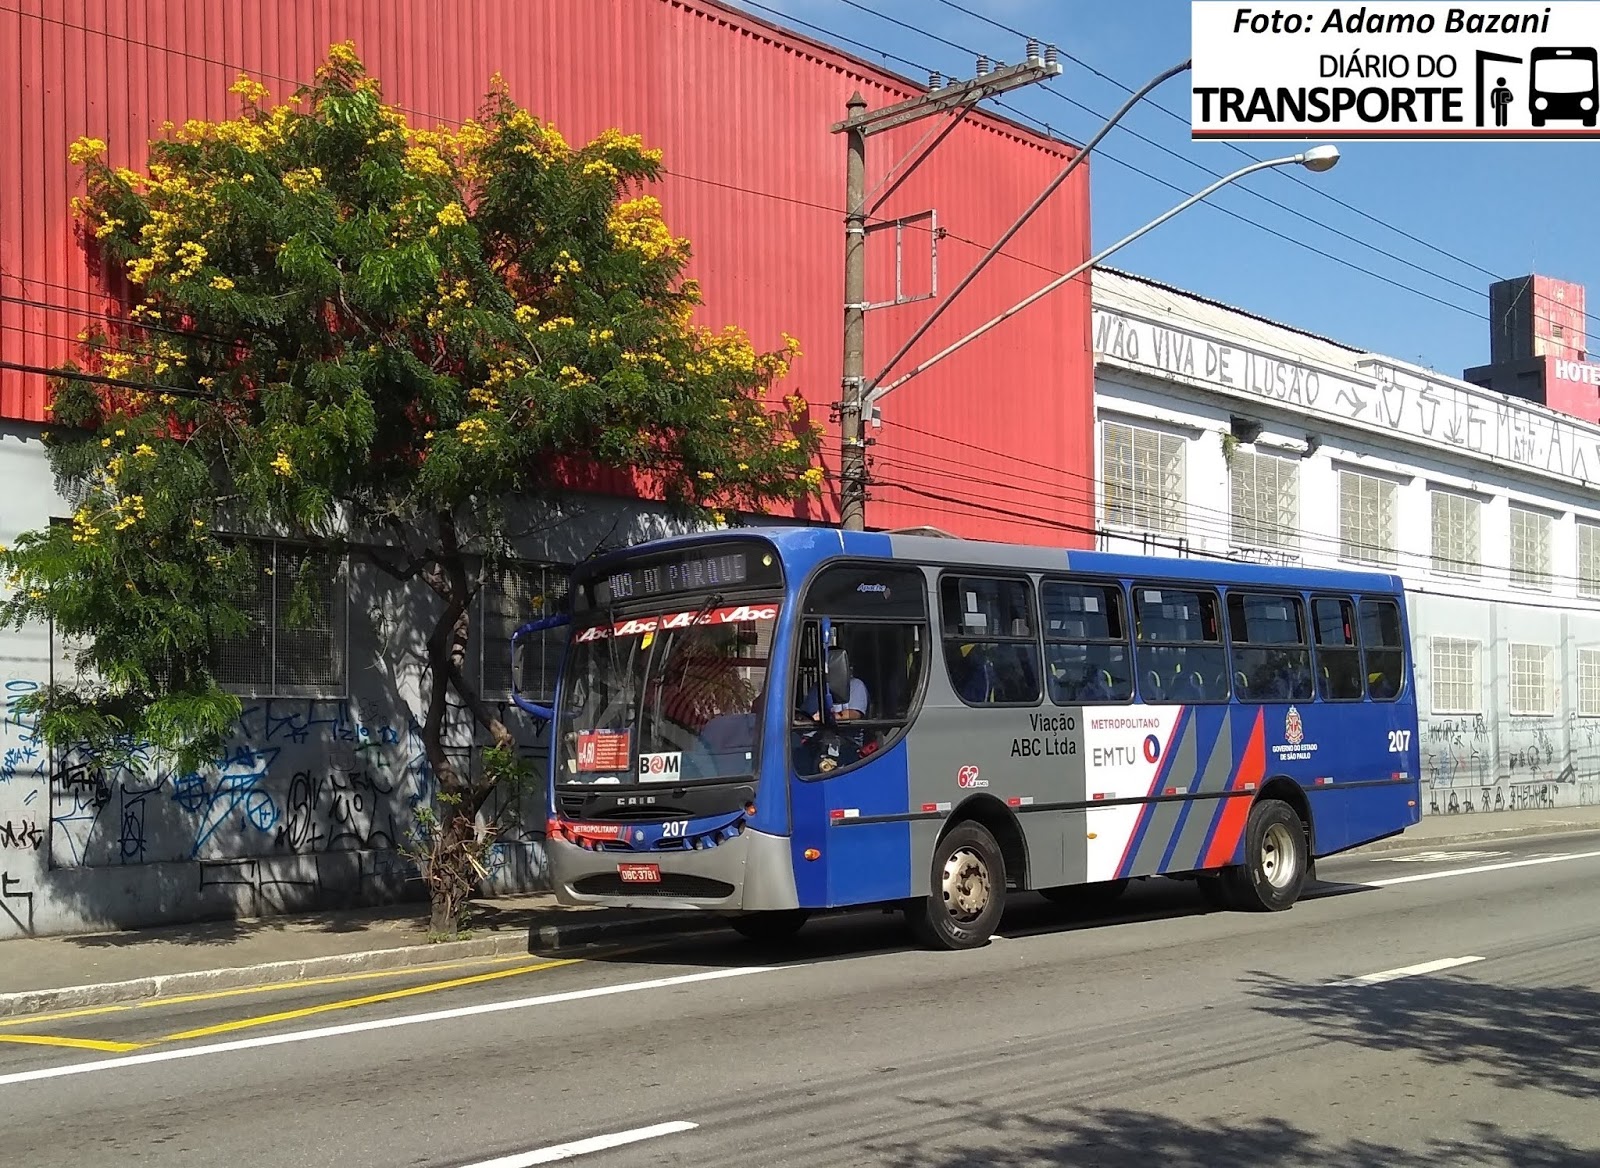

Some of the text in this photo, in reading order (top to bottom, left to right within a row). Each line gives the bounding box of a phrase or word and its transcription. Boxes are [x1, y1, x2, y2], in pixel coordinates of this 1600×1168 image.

[1096, 314, 1140, 361] NÃO
[1152, 327, 1195, 376] VIVA
[1205, 343, 1233, 384] DE
[669, 554, 745, 590] PARQUE
[1029, 713, 1075, 736] Viação
[1091, 718, 1160, 729] METROPOLITANO
[1011, 737, 1077, 757] ABC Ltda
[1388, 730, 1411, 752] 207
[1093, 747, 1136, 767] EMTU
[617, 797, 655, 805] CAIO
[573, 825, 618, 834] METROPOLITANO
[662, 821, 689, 837] 207
